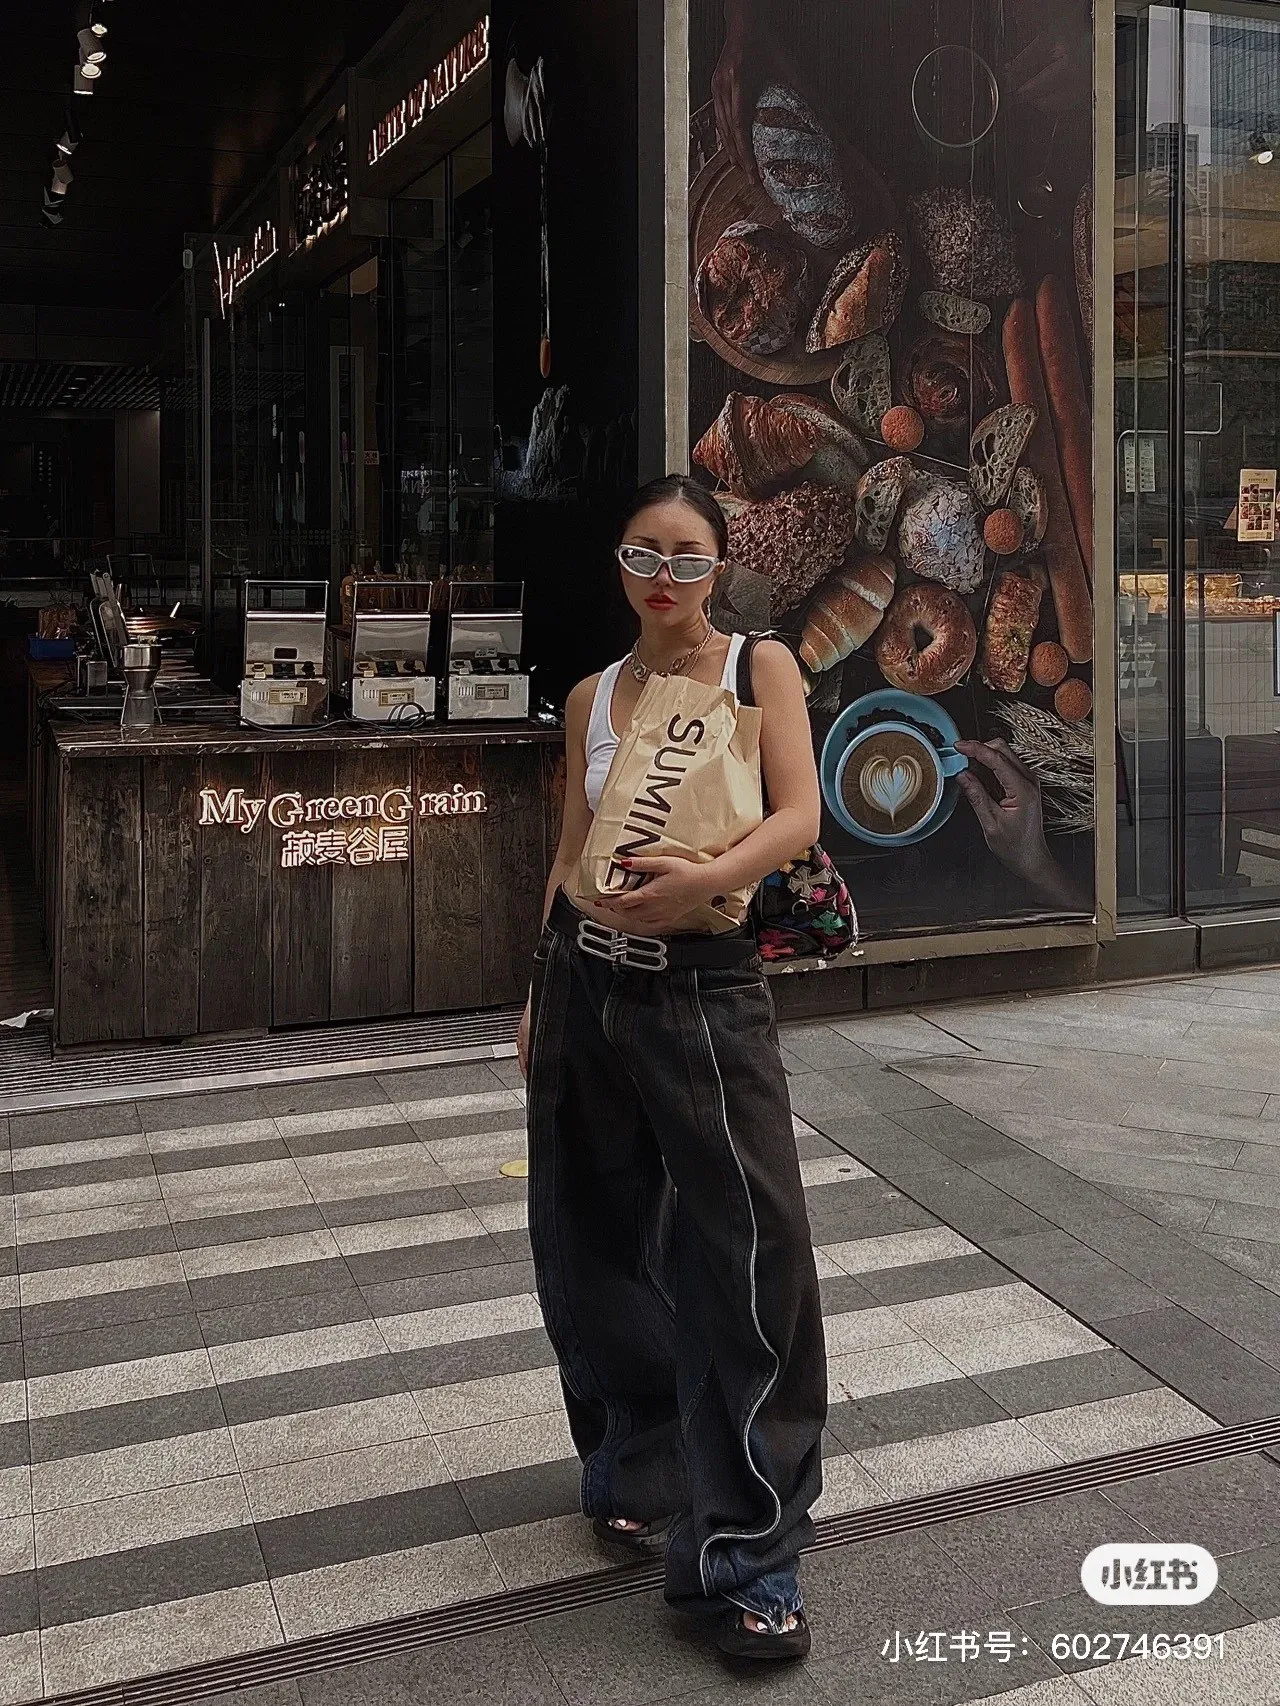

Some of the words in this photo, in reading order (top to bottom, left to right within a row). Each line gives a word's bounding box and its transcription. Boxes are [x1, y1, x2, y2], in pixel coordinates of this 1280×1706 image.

[378, 99, 406, 156] BITE
[406, 78, 428, 127] OF
[428, 14, 490, 110] NATURE
[604, 712, 705, 892] SUMINE
